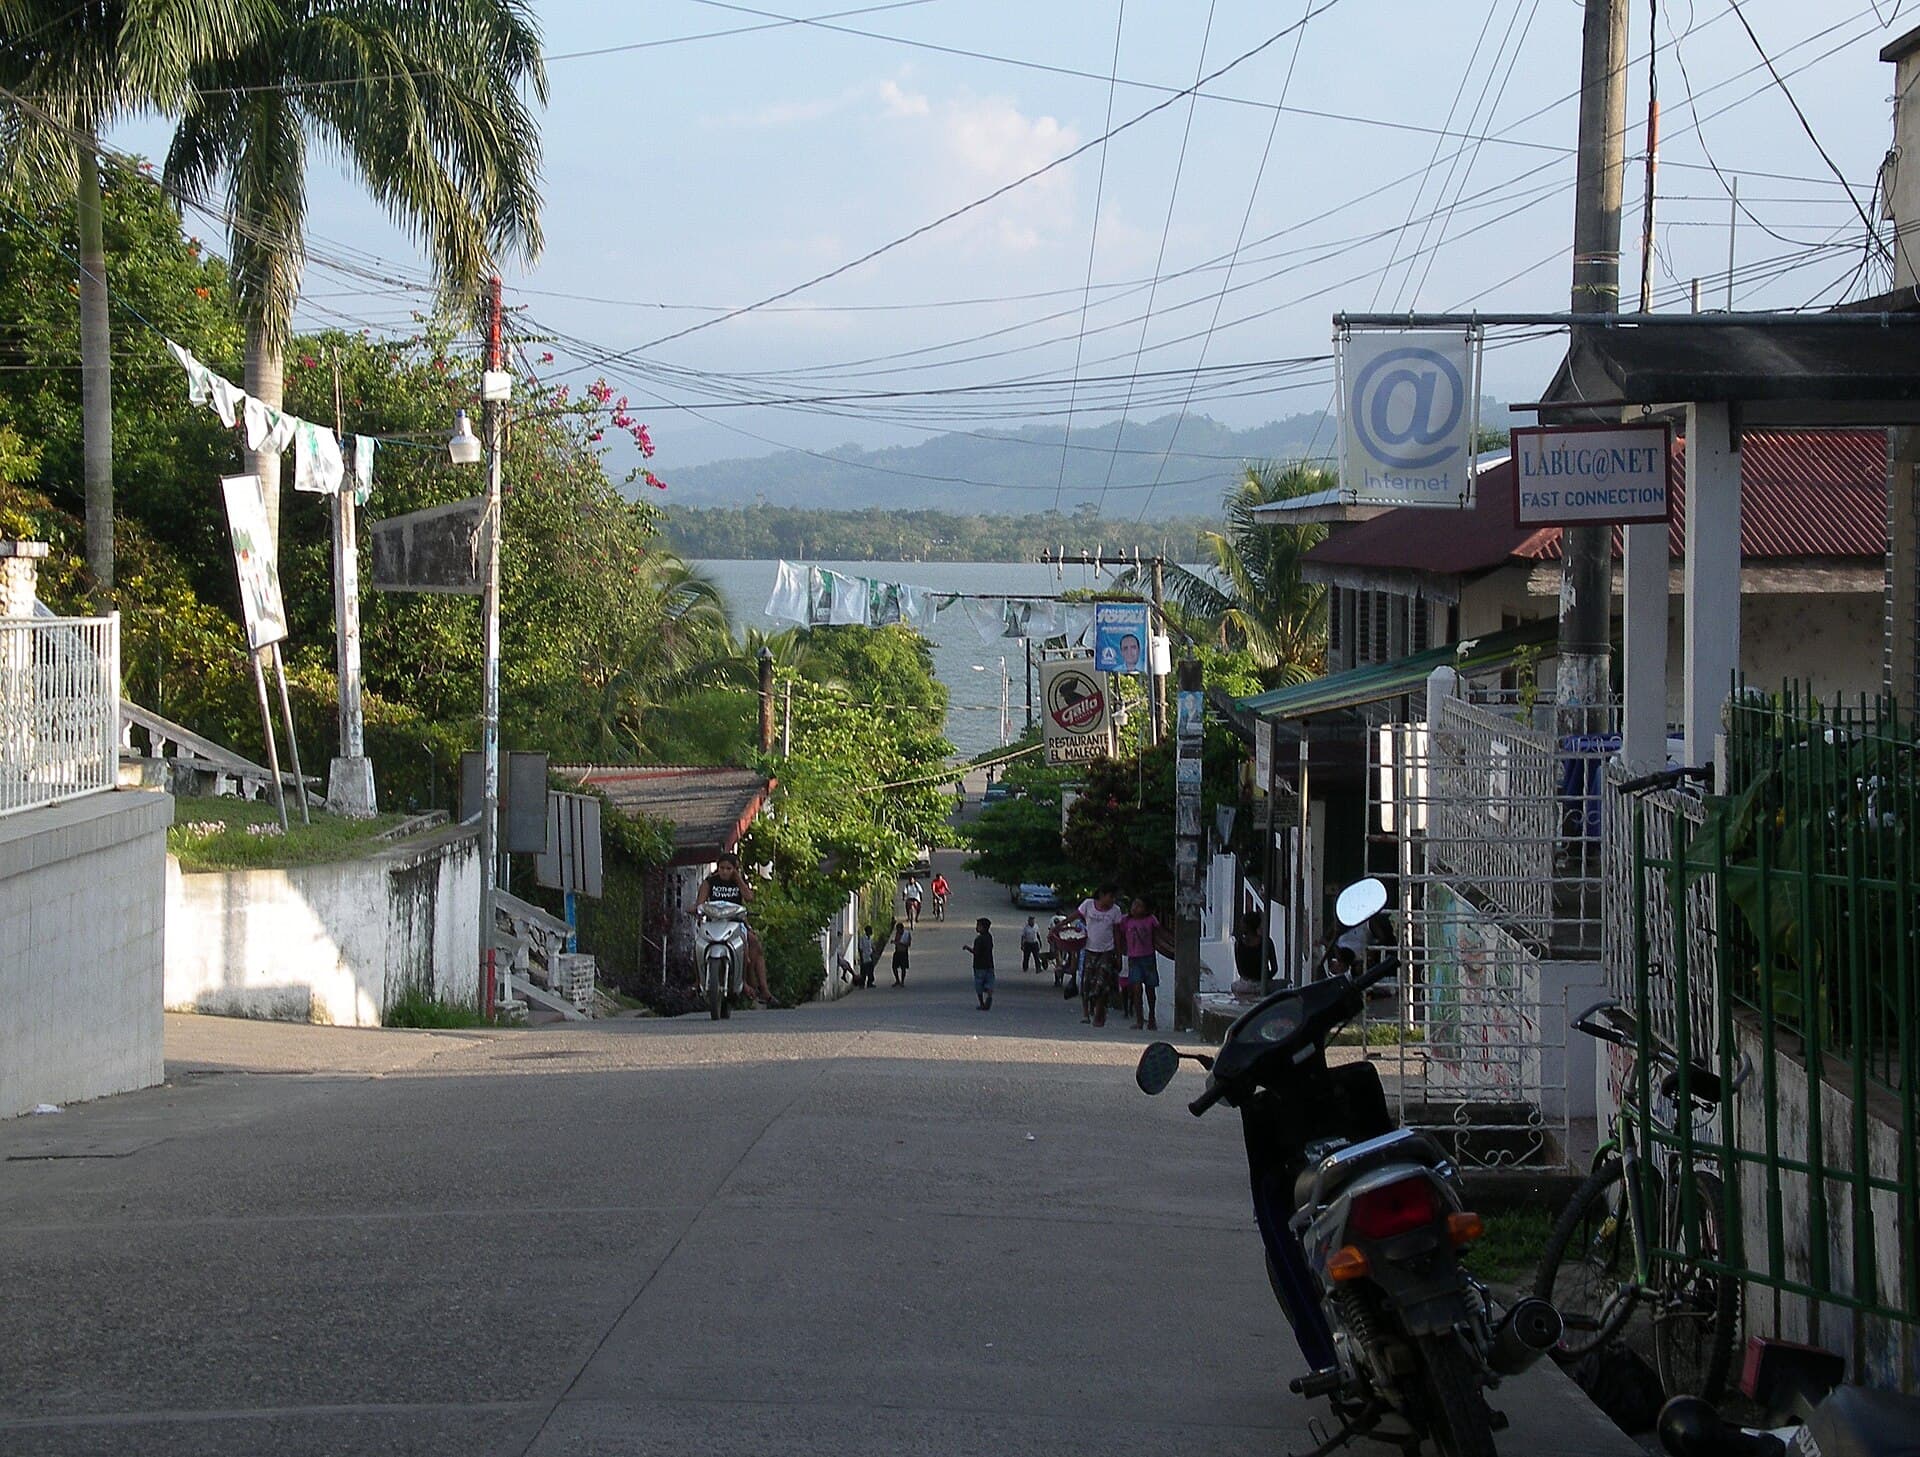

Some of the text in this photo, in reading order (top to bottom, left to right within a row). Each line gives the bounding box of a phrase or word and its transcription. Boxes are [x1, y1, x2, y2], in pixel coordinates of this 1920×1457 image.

[1524, 448, 1658, 481] LABUG@NET
[1364, 468, 1449, 491] Internet
[1522, 488, 1664, 508] FAST CONNECTION
[1062, 698, 1097, 724] Gallo
[1049, 734, 1109, 748] RESTAURANTE
[1051, 746, 1108, 760] EL MALECON
